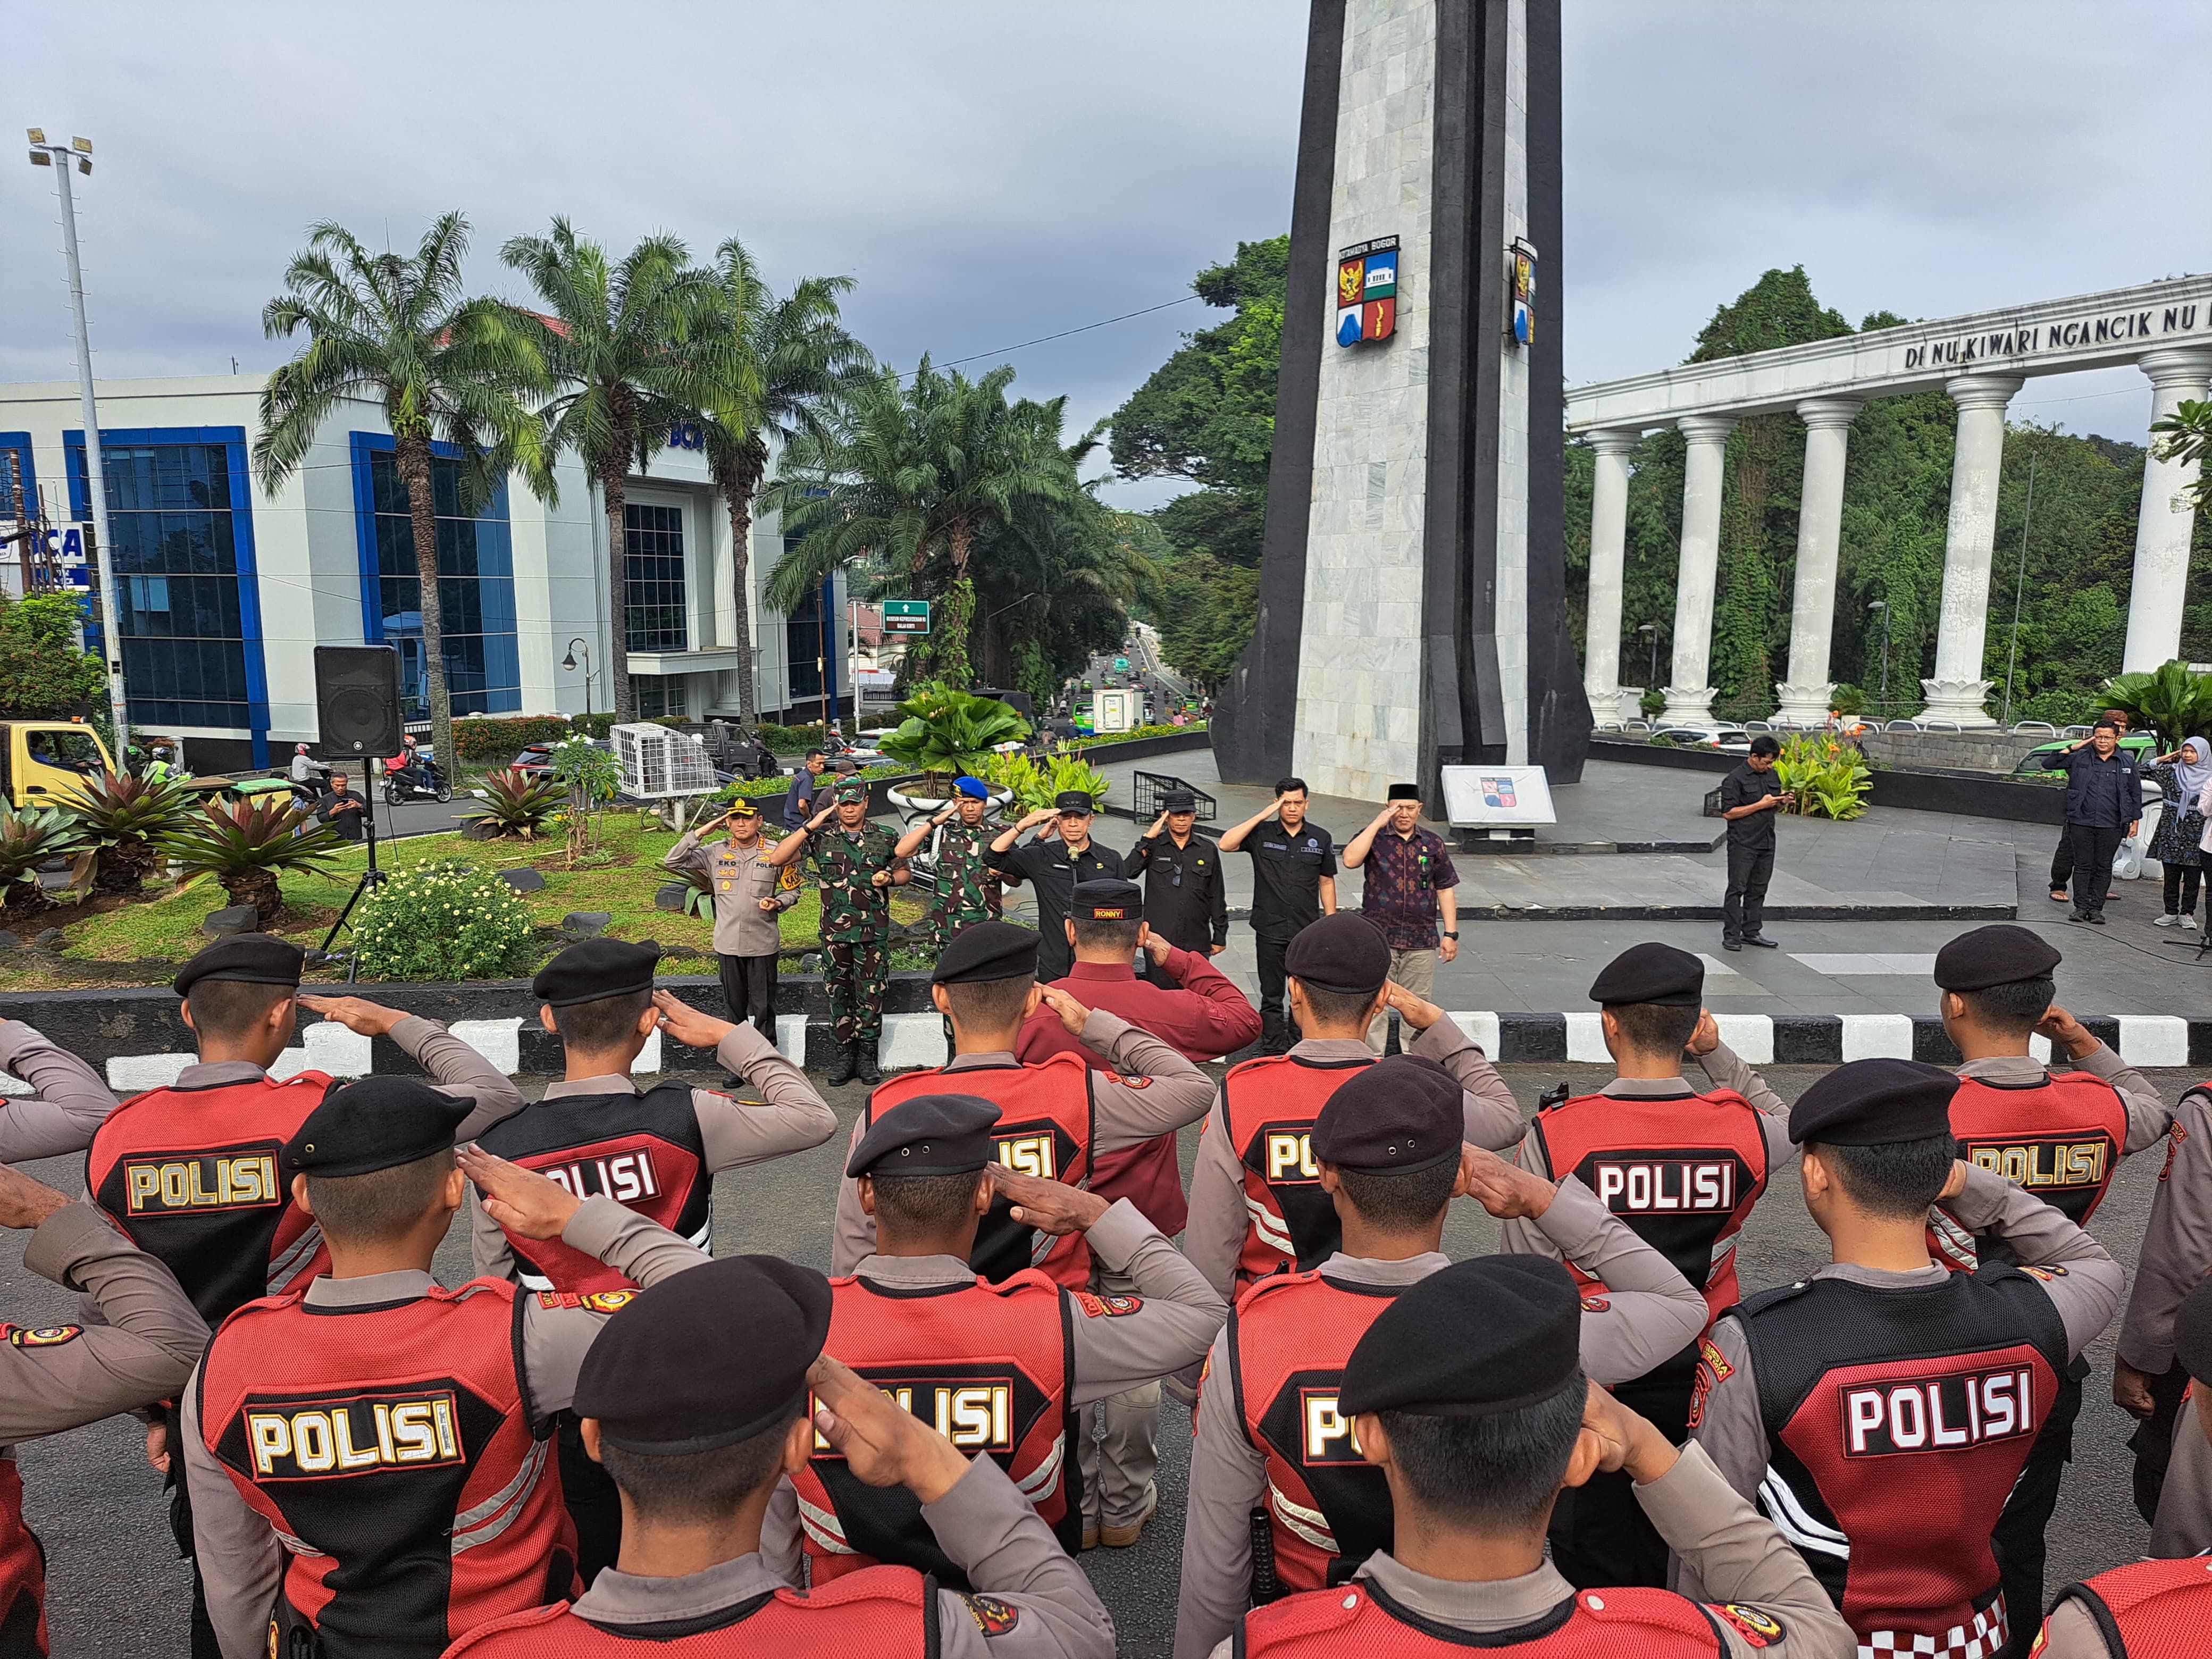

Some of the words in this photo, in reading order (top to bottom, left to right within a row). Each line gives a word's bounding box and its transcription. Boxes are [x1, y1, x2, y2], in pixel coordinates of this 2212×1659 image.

[1371, 237, 1396, 250] BOGOR
[1905, 345, 1925, 368] DI
[1932, 341, 1957, 364] NU
[1966, 327, 2039, 359] KIWARI
[2049, 311, 2153, 348] NGANCIK
[2163, 304, 2197, 332] NU
[128, 1157, 276, 1209] POLISI
[544, 1151, 656, 1203] OLISI
[999, 1137, 1053, 1178] ISI
[1598, 1163, 1732, 1210] POLISI
[249, 1400, 456, 1473] POLISI
[1847, 1369, 2031, 1453] POLISI
